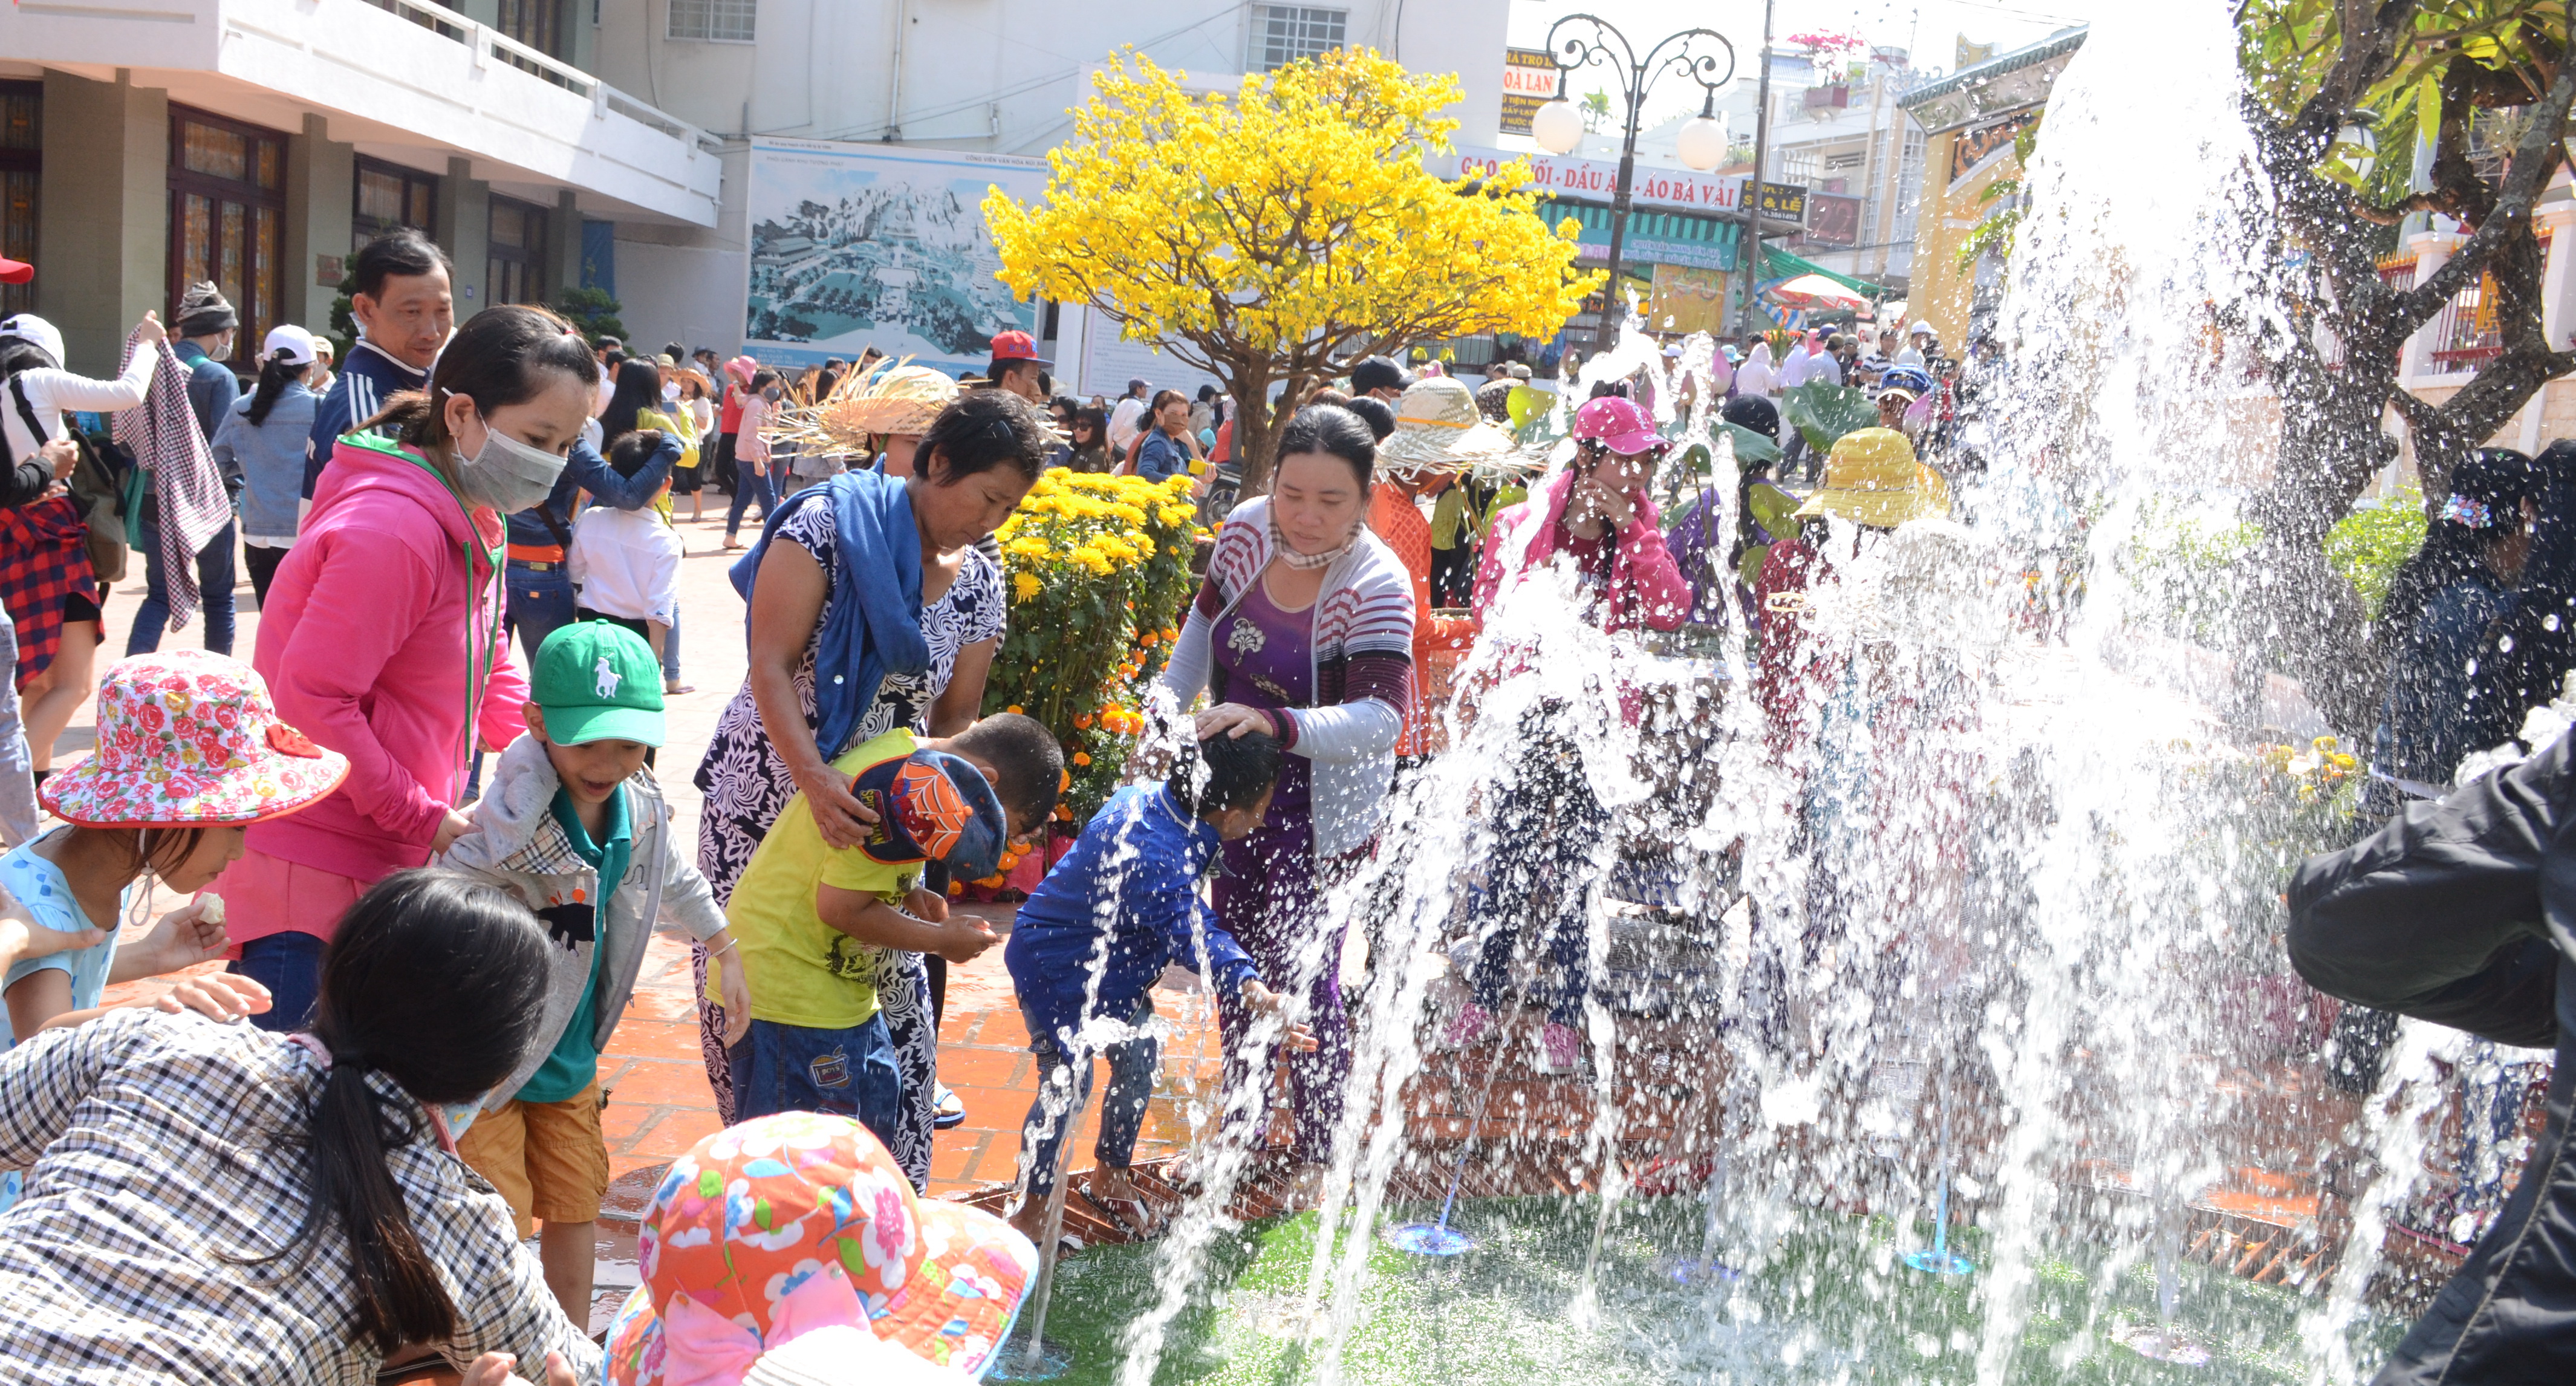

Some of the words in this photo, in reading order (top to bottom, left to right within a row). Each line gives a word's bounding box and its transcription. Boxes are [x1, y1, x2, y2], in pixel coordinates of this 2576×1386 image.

[1521, 54, 1543, 68] TRỌ
[1503, 65, 1522, 89] OÀ
[1525, 73, 1554, 93] LAN
[1564, 162, 1603, 191] DẦU
[1605, 168, 1618, 193] Ă
[1642, 172, 1669, 199] ÁO
[1671, 178, 1696, 203] BÀ
[1702, 178, 1735, 207] VẢI
[1743, 194, 1754, 206] S
[1763, 197, 1777, 209] &
[1781, 196, 1803, 212] LẺ
[1814, 198, 1854, 241] 22
